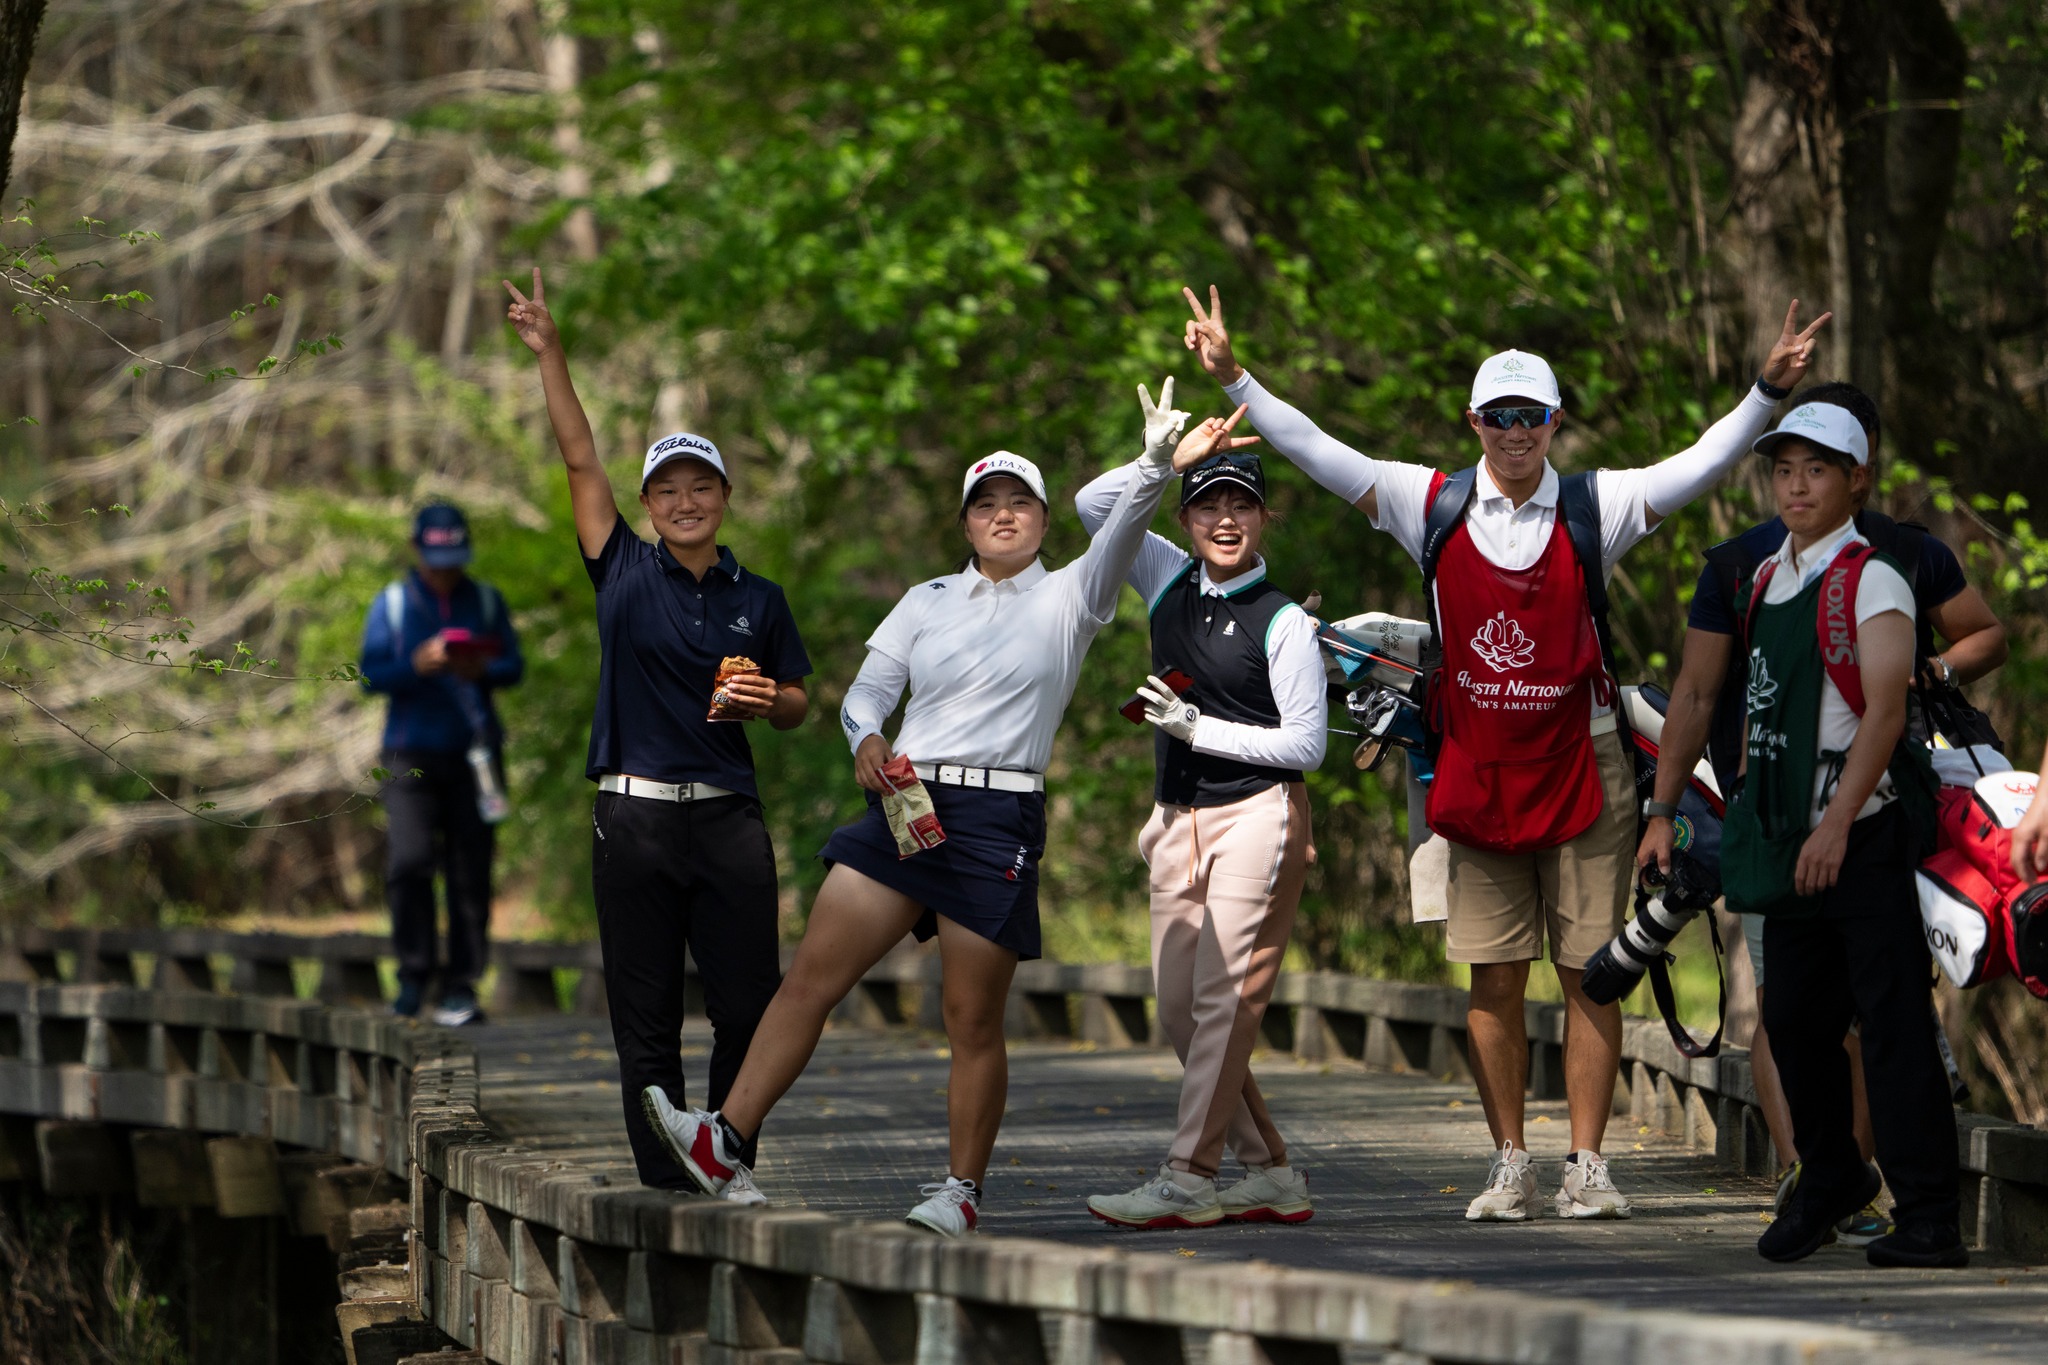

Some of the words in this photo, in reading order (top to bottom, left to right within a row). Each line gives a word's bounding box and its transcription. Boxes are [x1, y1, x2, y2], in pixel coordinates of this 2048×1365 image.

[651, 437, 713, 462] Titleist
[1825, 567, 1855, 666] SRIXON
[1636, 767, 1656, 787] SSEL
[1011, 845, 1028, 880] JAPAN
[1926, 921, 1958, 957] XON
